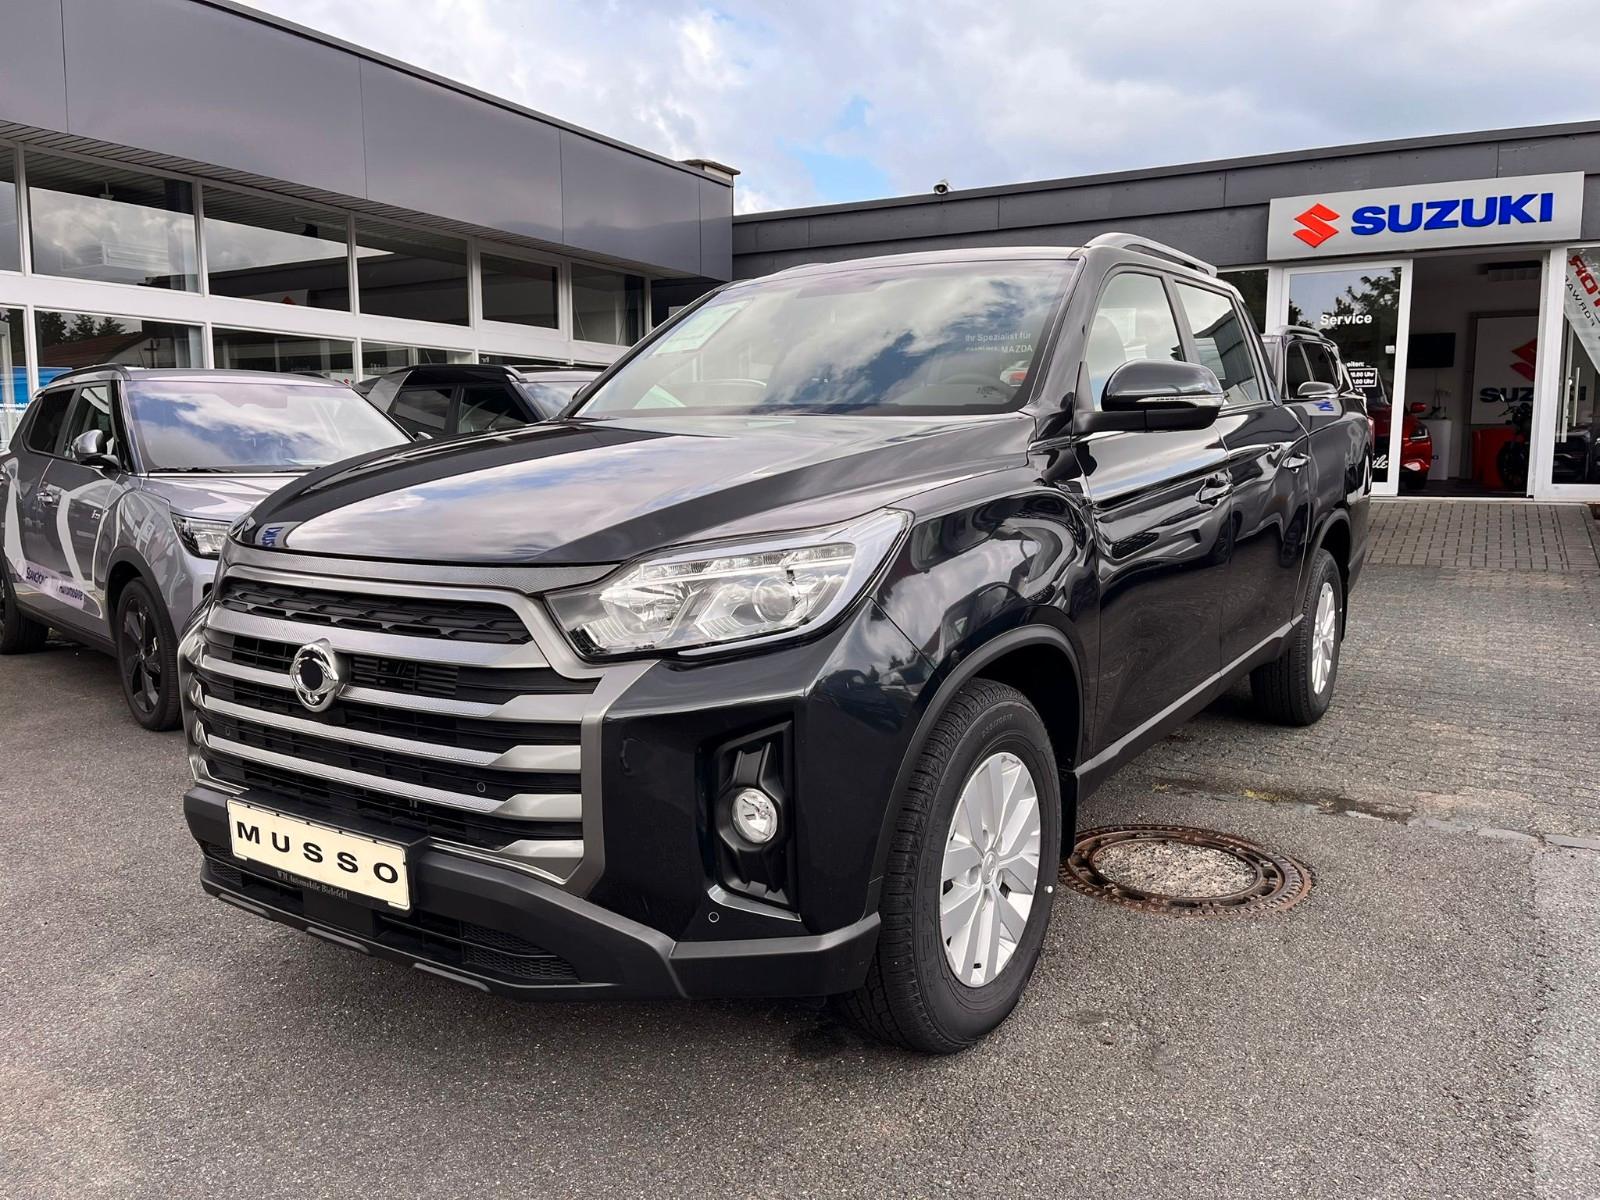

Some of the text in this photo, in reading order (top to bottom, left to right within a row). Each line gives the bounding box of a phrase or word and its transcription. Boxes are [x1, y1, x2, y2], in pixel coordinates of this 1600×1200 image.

[1351, 193, 1553, 235] SUZUKI
[1320, 313, 1373, 325] Service
[977, 332, 1018, 343] Spezialist
[1001, 344, 1033, 353] MAZDA
[237, 821, 399, 884] MUSSO
